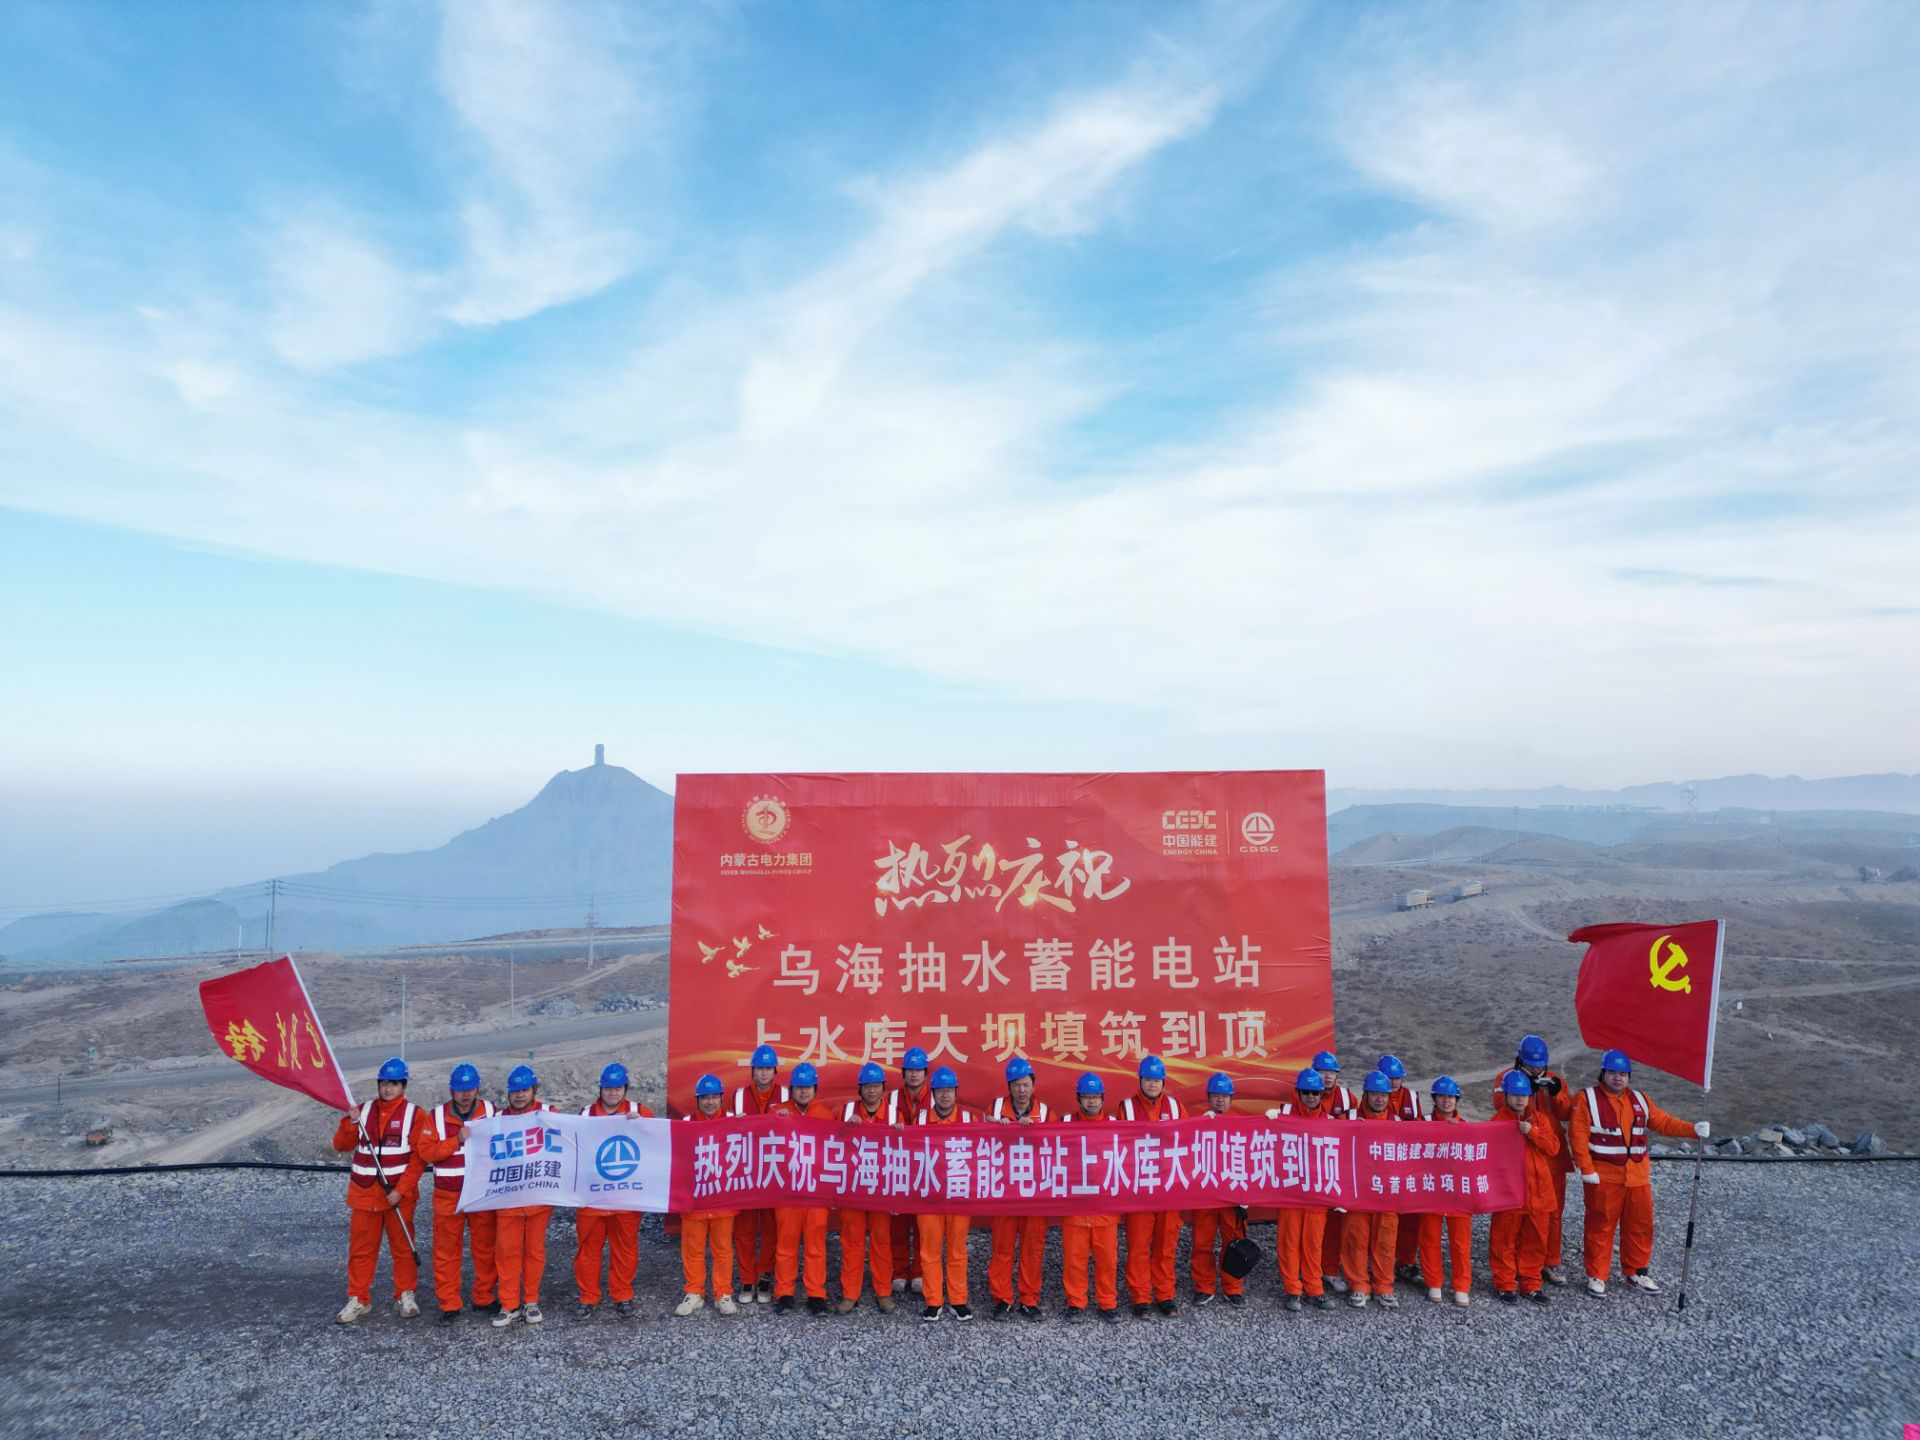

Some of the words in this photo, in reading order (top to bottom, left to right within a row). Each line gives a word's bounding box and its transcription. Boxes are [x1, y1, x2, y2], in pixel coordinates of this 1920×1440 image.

[1163, 833, 1218, 848] 中国能建
[720, 853, 813, 867] 内蒙古电力集团
[873, 834, 1131, 917] 热烈庆祝
[773, 936, 1262, 995] 乌海抽水蓄能电站
[737, 1010, 1269, 1067] 上水库大坝填筑到顶
[1369, 1142, 1488, 1162] 中国能建葛洲坝集团
[489, 1160, 562, 1185] 中国能建
[693, 1129, 1342, 1199] 热烈庆祝乌海抽水蓄能电站上水库大坝填筑到顶
[485, 1184, 525, 1197] ENERGY
[528, 1181, 560, 1190] CHINA
[1371, 1174, 1489, 1194] 乌蓄电站项目部
